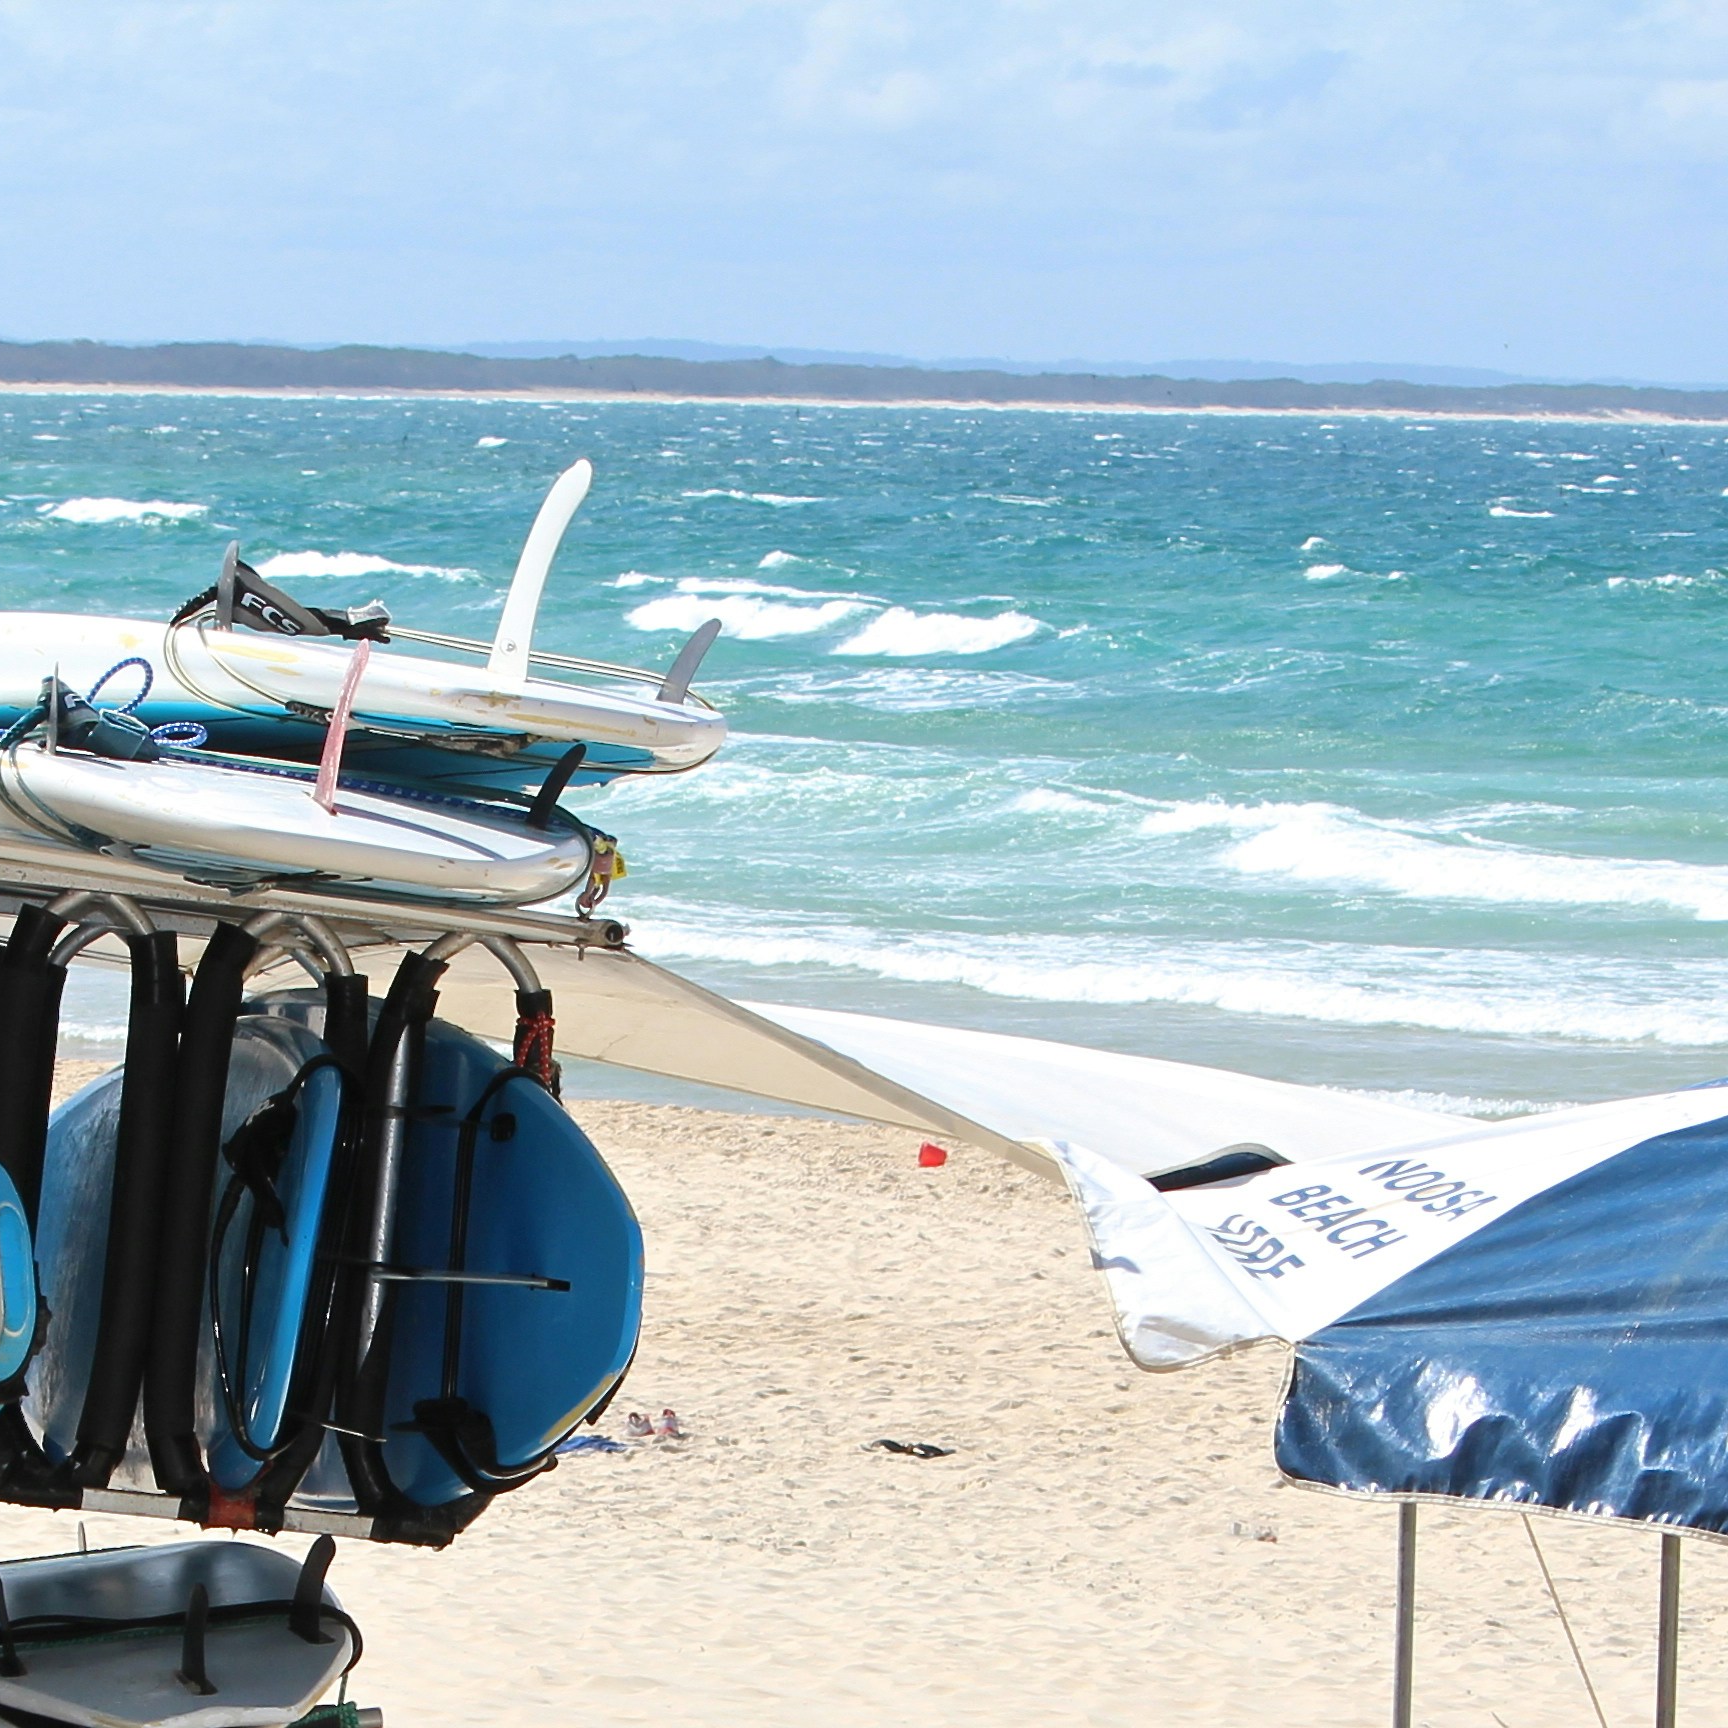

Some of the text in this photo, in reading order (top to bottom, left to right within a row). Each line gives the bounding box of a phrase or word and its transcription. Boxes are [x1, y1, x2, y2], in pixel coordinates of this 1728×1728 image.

[241, 592, 301, 635] FCS
[1268, 1183, 1409, 1260] BEACH
[1357, 1158, 1499, 1222] NOOSA
